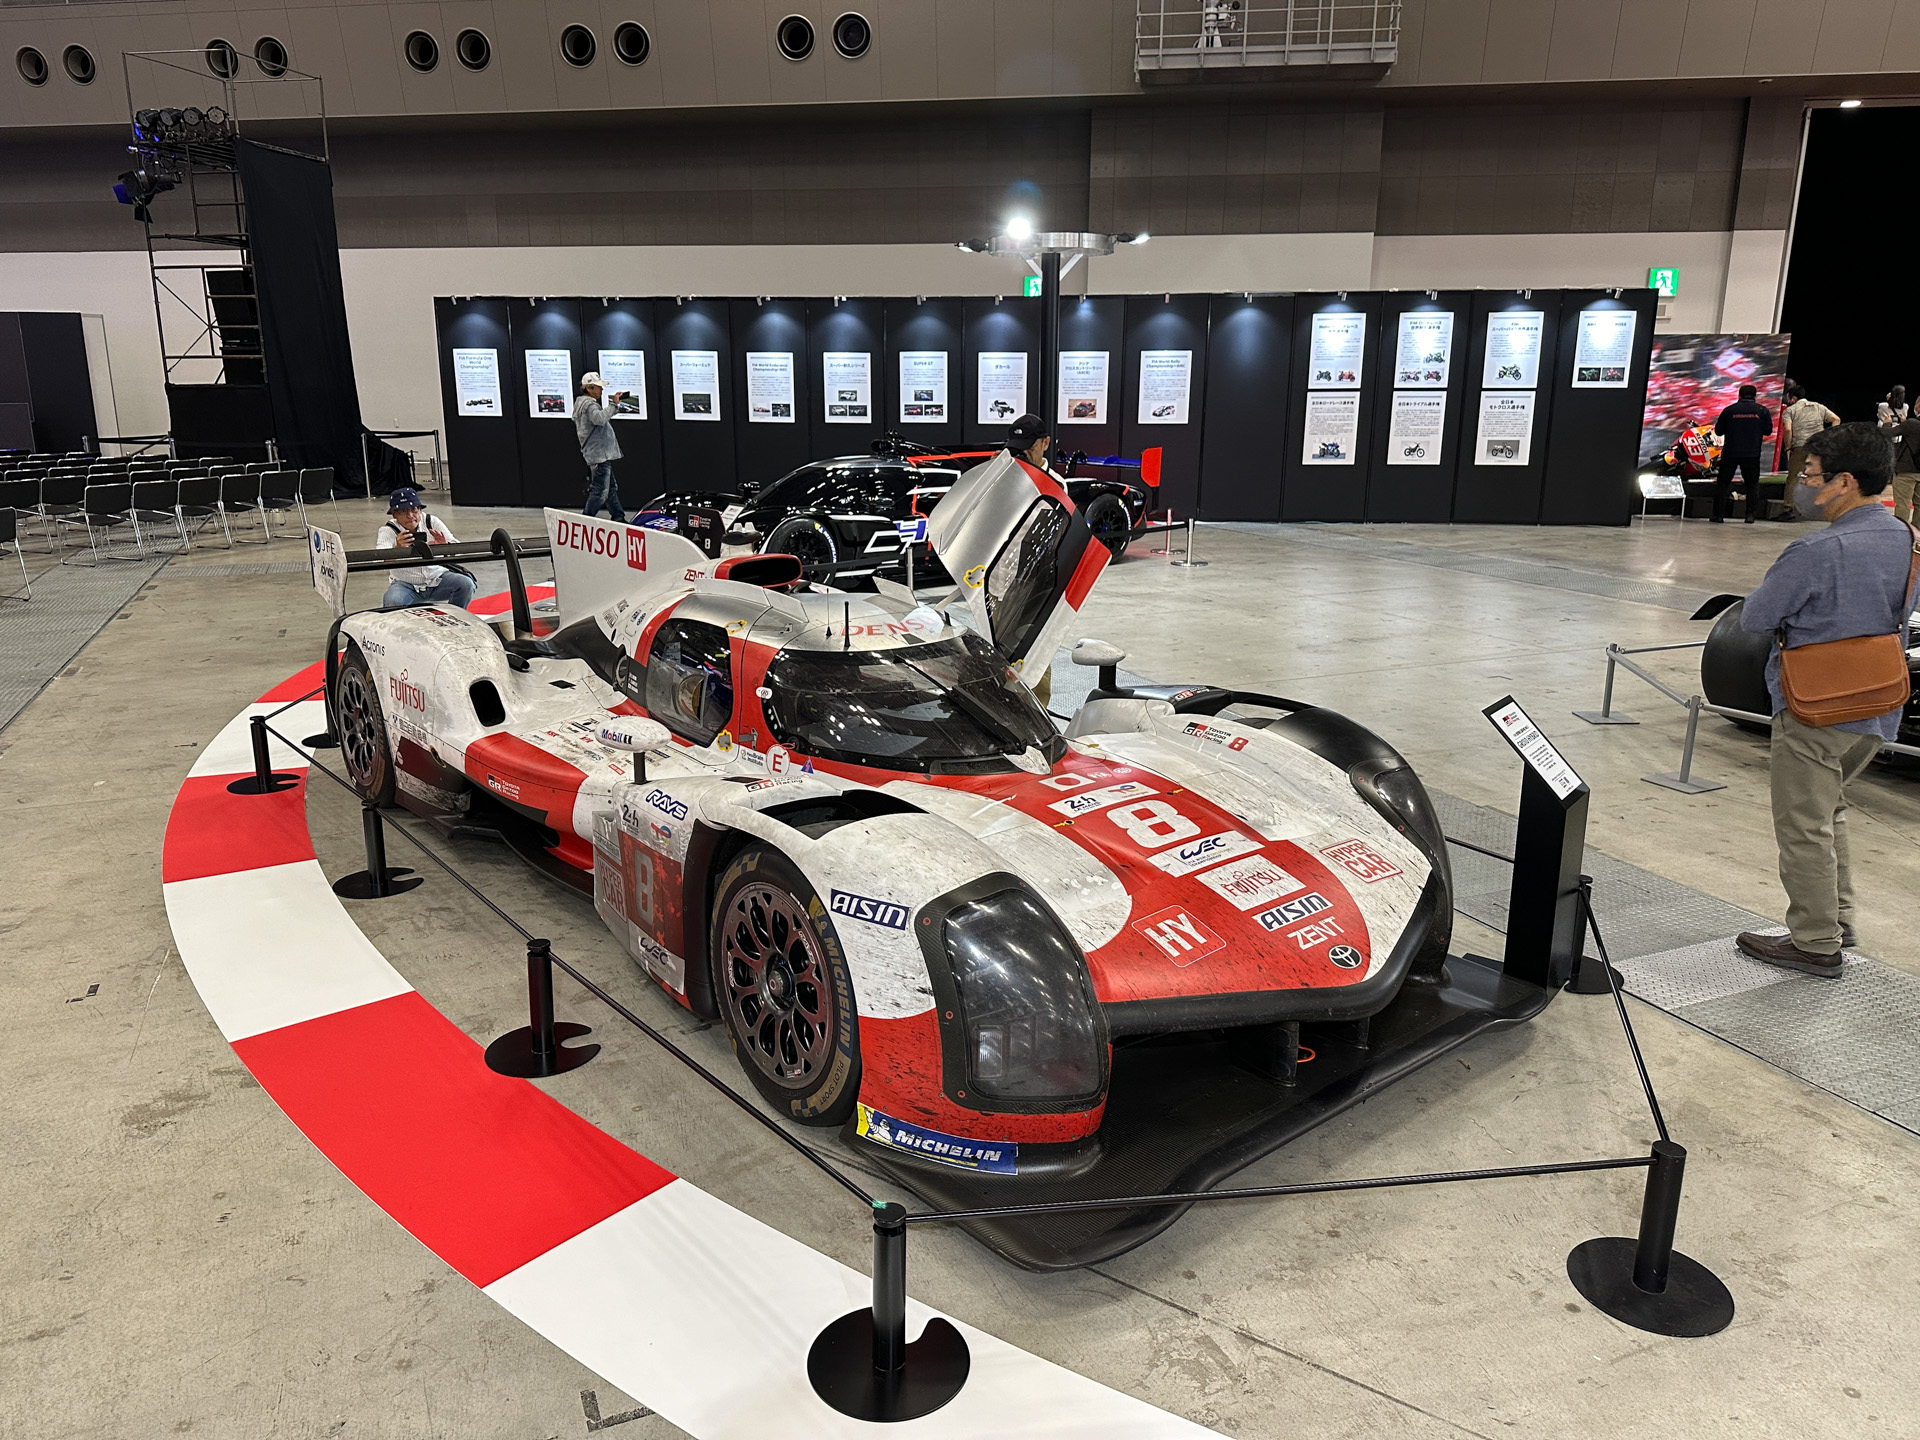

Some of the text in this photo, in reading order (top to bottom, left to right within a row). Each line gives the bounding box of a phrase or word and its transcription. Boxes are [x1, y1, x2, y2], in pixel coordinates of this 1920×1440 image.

[322, 539, 336, 555] JFE
[557, 520, 645, 564] DENSO HY
[704, 538, 711, 550] 8
[684, 568, 705, 582] ZENT
[841, 616, 939, 636] DENSO
[361, 636, 386, 657] Acronis
[389, 676, 426, 713] FUJITSU
[601, 729, 622, 742] Mobil
[1208, 726, 1232, 737] TOYOTA
[1227, 736, 1249, 752] 8
[646, 788, 688, 821] RAYS
[1106, 799, 1202, 848] 8
[1180, 837, 1226, 859] WEC
[1327, 842, 1372, 863] HYPER
[1344, 853, 1397, 878] CAR
[634, 848, 654, 926] 8
[1222, 869, 1282, 898] FUJITSU
[832, 894, 906, 927] AISIN
[1260, 894, 1329, 931] AISIN
[1143, 913, 1208, 958] HY
[1287, 915, 1346, 950] ZENT
[640, 937, 668, 966] WEC
[822, 938, 851, 1051] MICHELIN
[820, 1060, 845, 1105] PILOT SPORT
[894, 1129, 1002, 1162] MICHELIN
